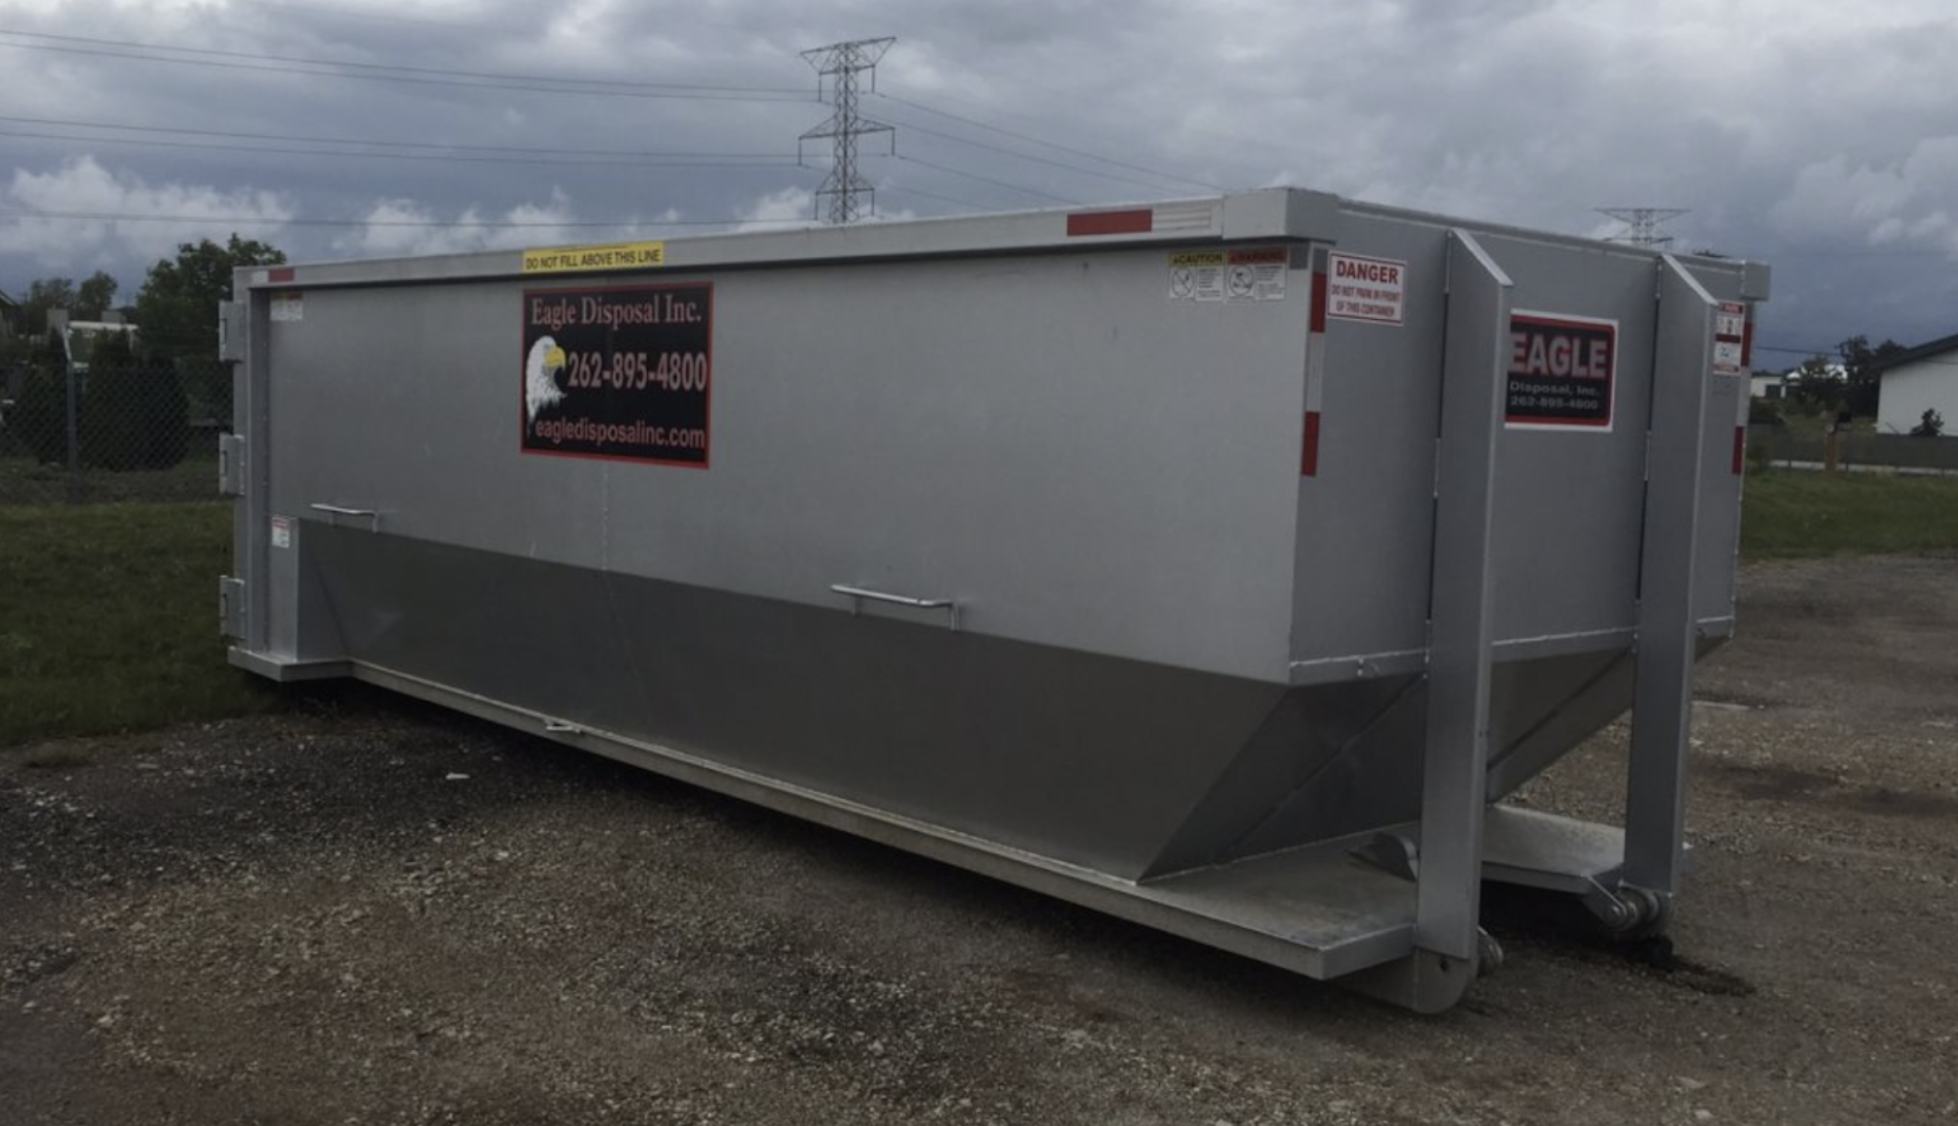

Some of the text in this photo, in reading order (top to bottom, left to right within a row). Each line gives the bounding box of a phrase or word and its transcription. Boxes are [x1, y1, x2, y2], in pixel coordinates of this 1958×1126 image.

[526, 249, 660, 269] DO NOT FILL ABOVE THIS LINE
[1180, 253, 1222, 264] CAUTION
[1336, 260, 1398, 284] DANGER
[531, 294, 701, 331] Eagle Disposal Inc.
[1508, 331, 1607, 379] EAGLE
[568, 352, 707, 391] 262-895-4800
[536, 417, 704, 448] eagledisposalinc.com
